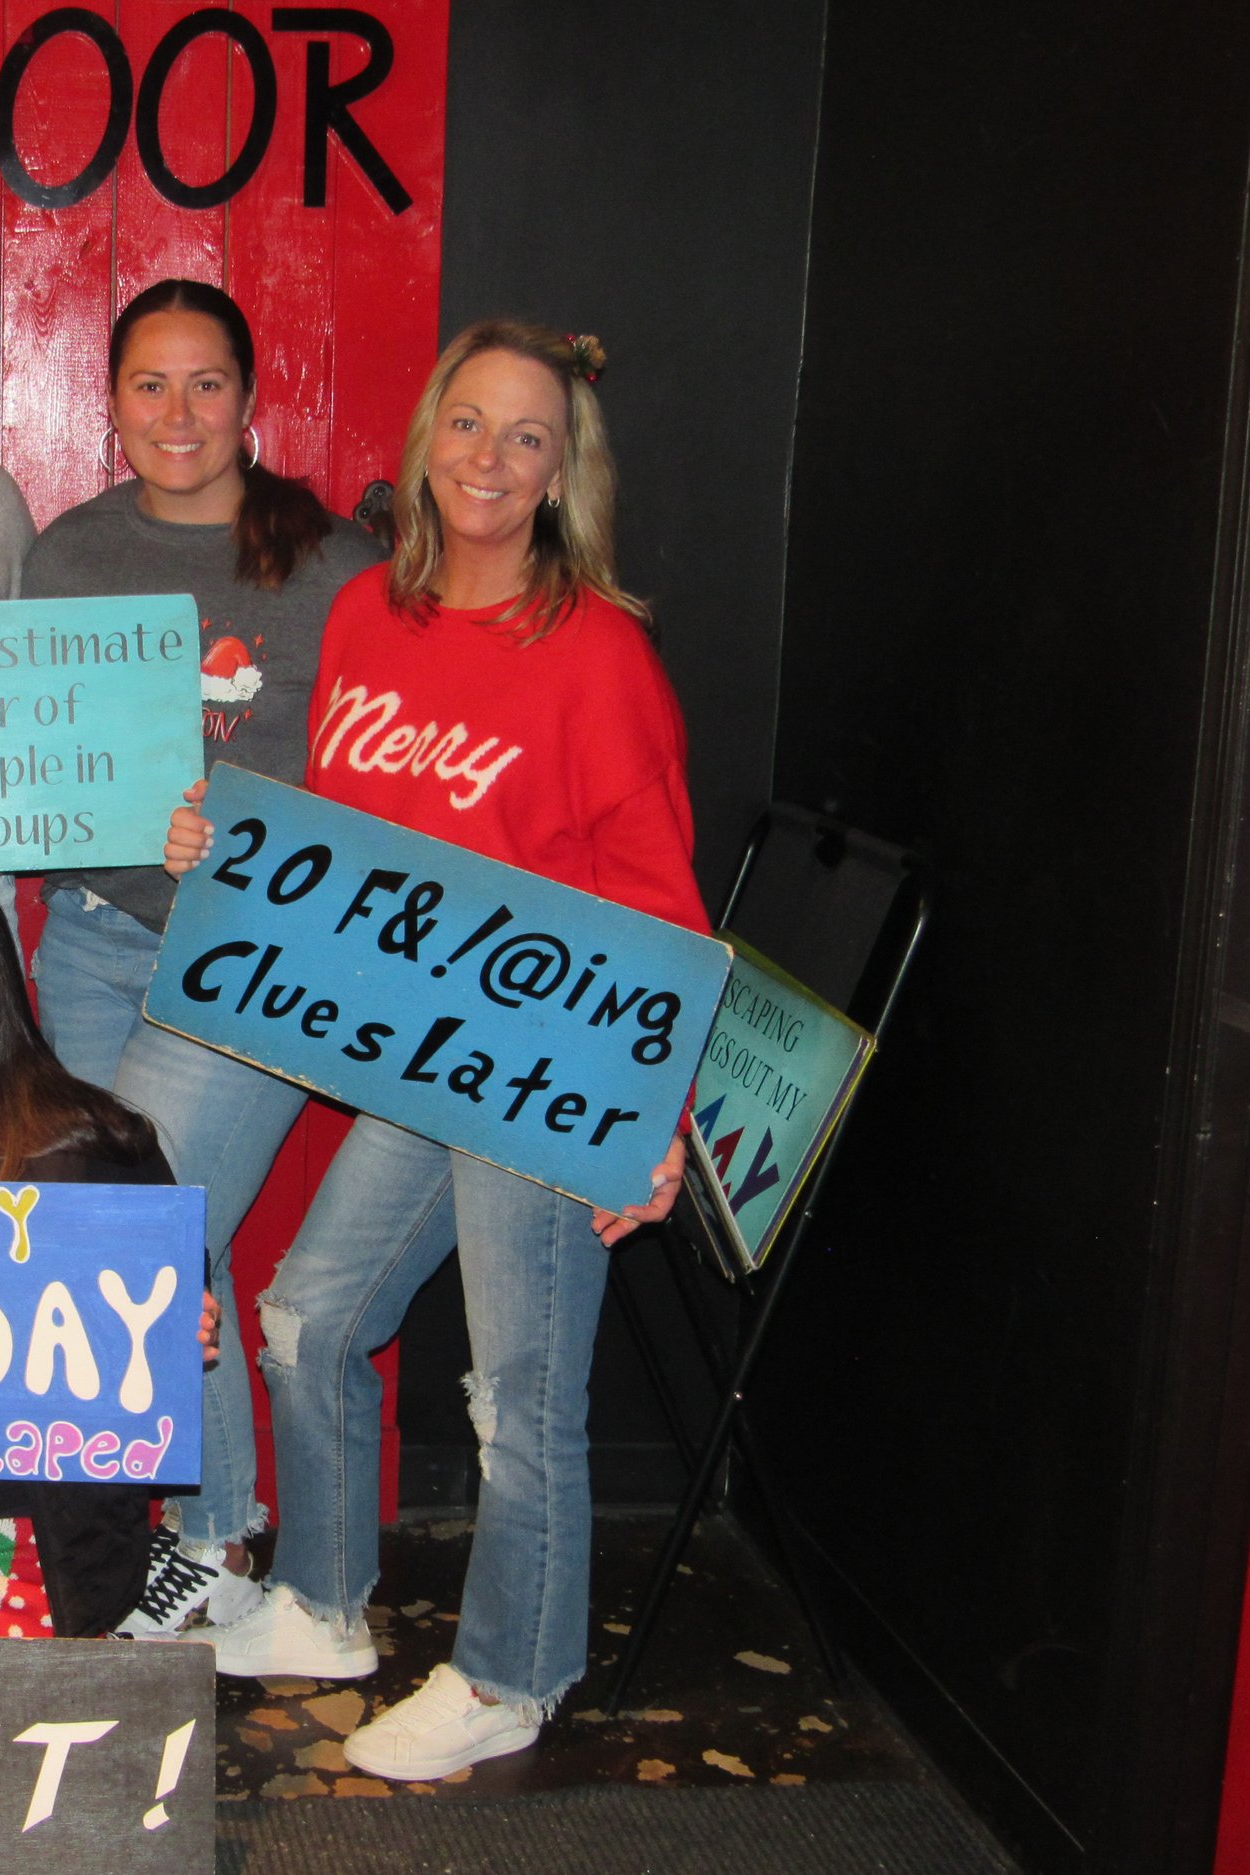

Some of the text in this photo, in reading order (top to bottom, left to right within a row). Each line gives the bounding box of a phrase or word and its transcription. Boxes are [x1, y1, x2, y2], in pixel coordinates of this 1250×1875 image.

[34, 683, 85, 726] of
[312, 677, 523, 810] Merry
[76, 744, 114, 783] in
[211, 817, 332, 905] 20
[181, 940, 640, 1146] Clues Later
[722, 978, 804, 1053] SCAPING
[709, 1027, 807, 1121] GS OUT MY
